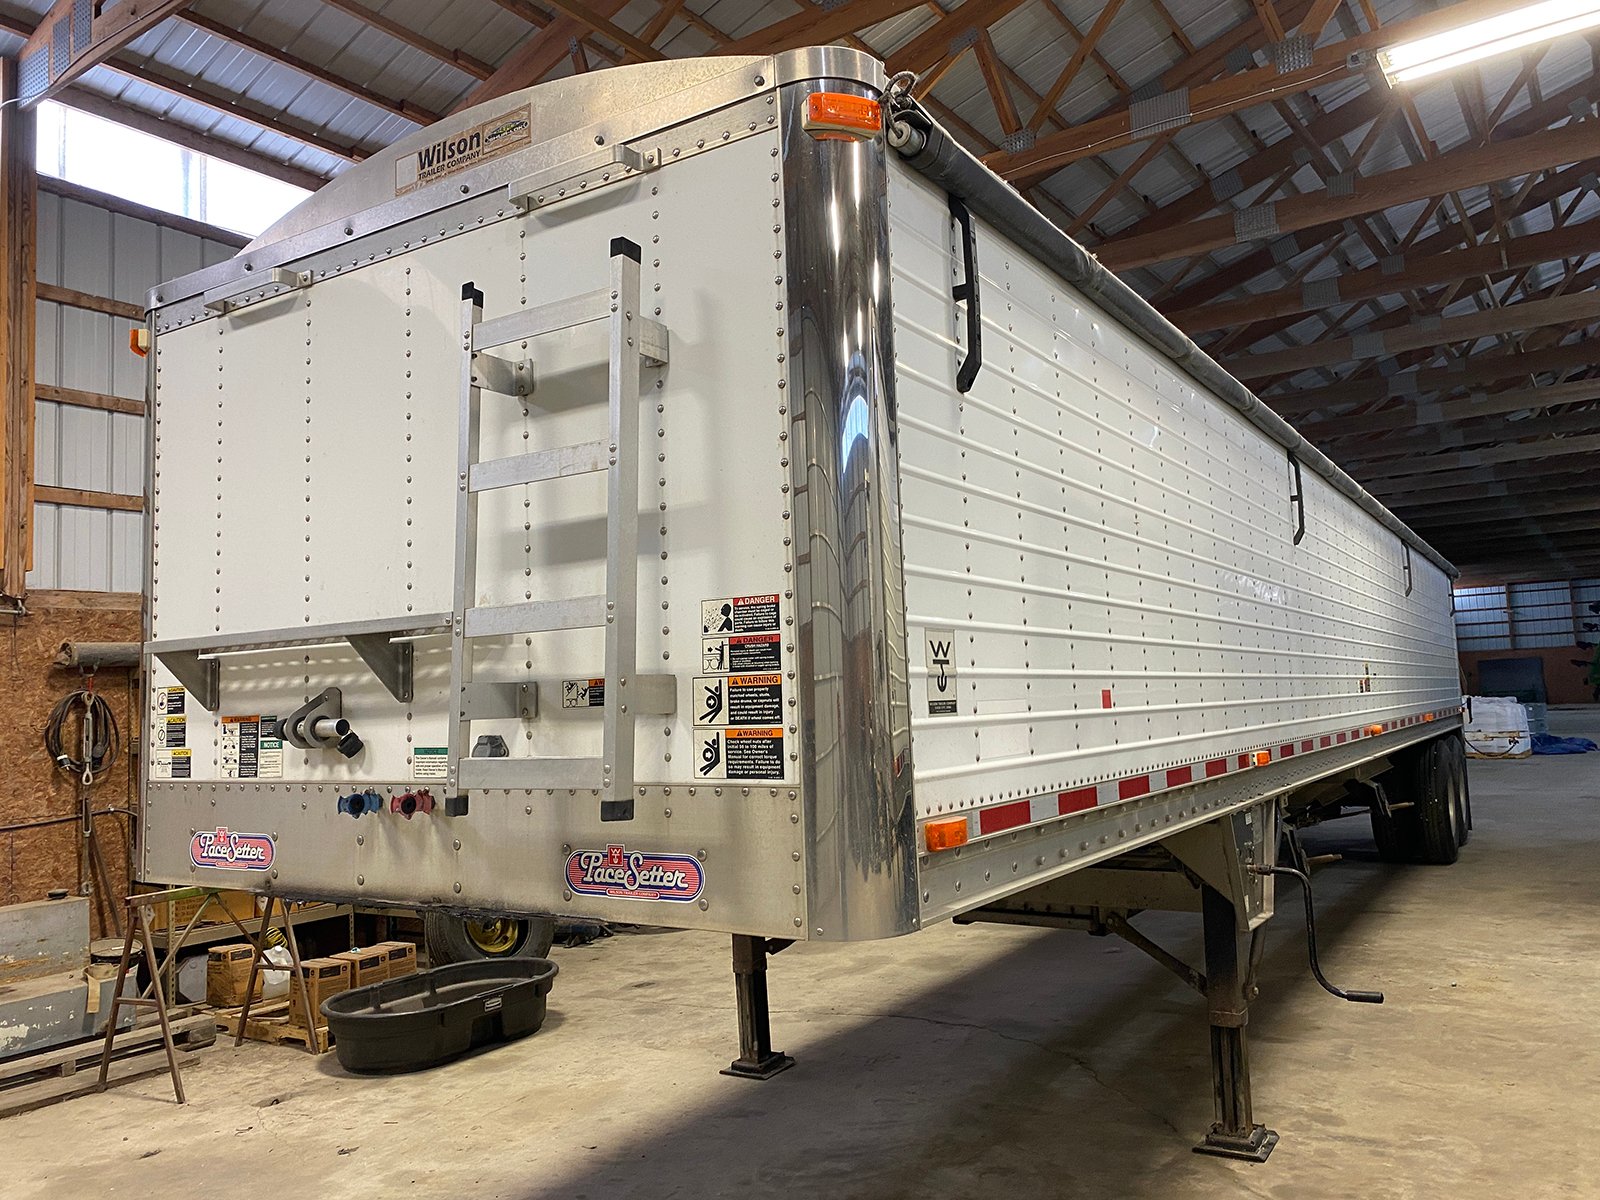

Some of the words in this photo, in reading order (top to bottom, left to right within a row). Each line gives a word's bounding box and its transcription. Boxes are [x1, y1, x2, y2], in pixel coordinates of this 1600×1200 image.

[418, 131, 481, 171] Wilson
[418, 164, 446, 181] TRAILER
[446, 150, 482, 170] COMPANY
[745, 595, 775, 605] DANGER
[740, 676, 778, 685] WARNING
[200, 834, 265, 862] PaceSetter
[580, 852, 689, 890] PaceSetter
